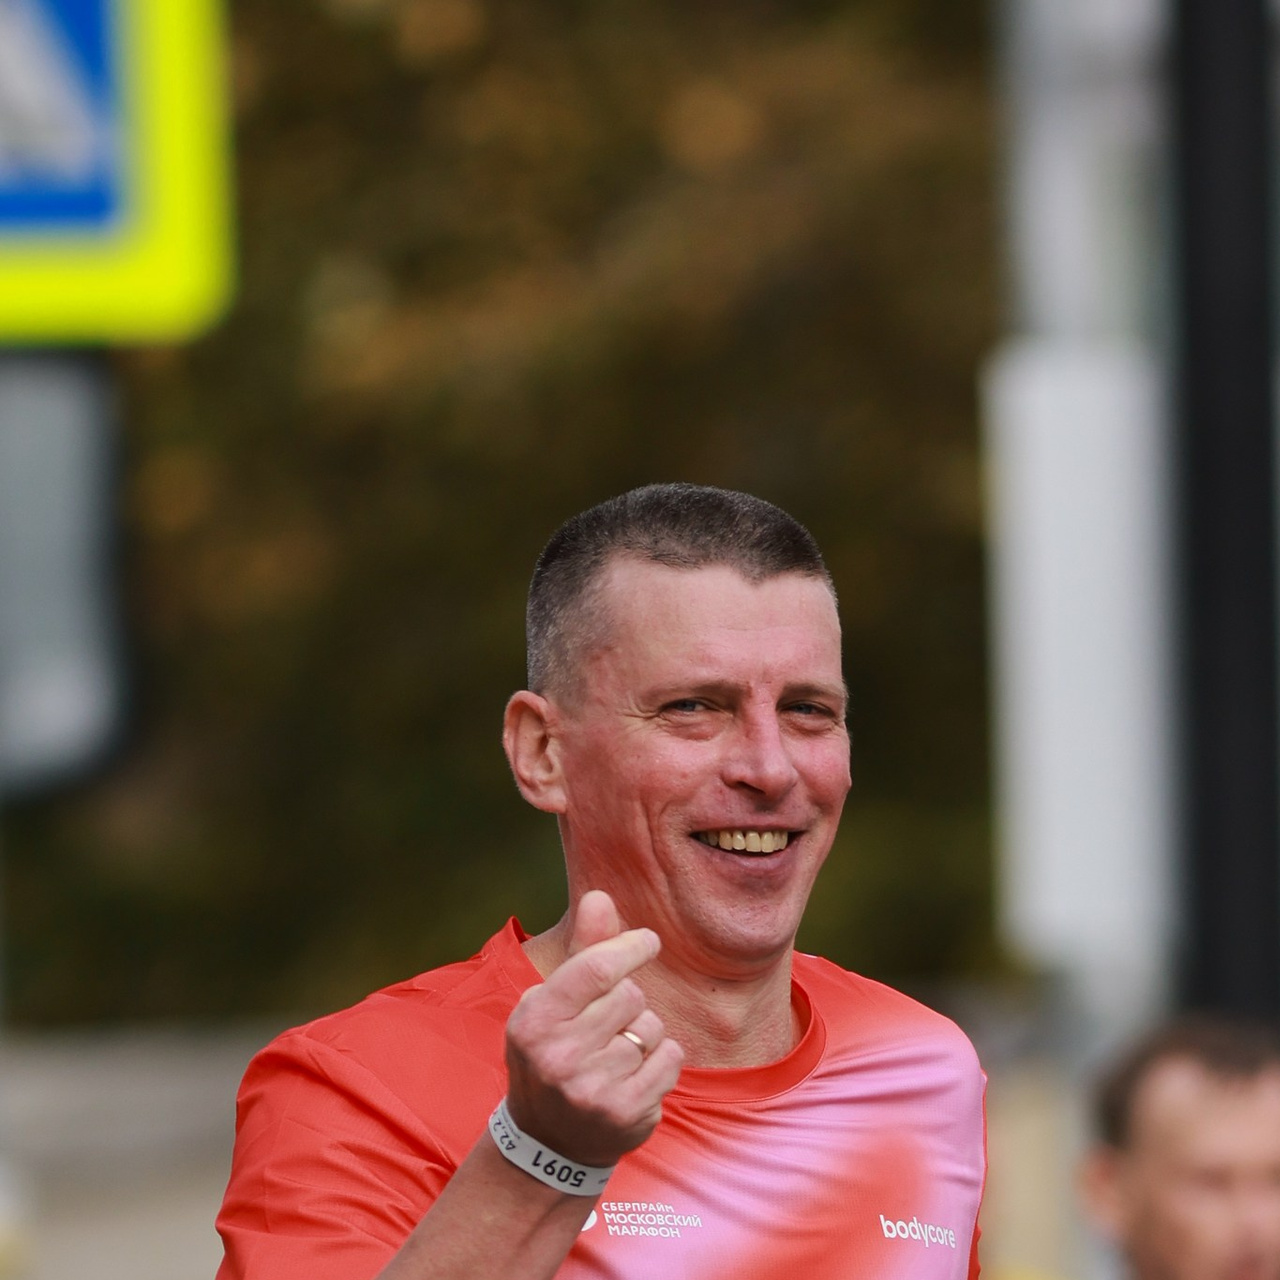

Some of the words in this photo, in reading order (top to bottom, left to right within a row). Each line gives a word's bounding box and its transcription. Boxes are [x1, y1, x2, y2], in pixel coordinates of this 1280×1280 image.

[532, 1150, 587, 1188] 5091
[601, 1202, 675, 1212] СБЕРПРАЙМ
[603, 1213, 703, 1228] МОСКОВСКИЙ
[607, 1225, 681, 1238] МАРАФОН
[879, 1214, 956, 1248] bodycore
